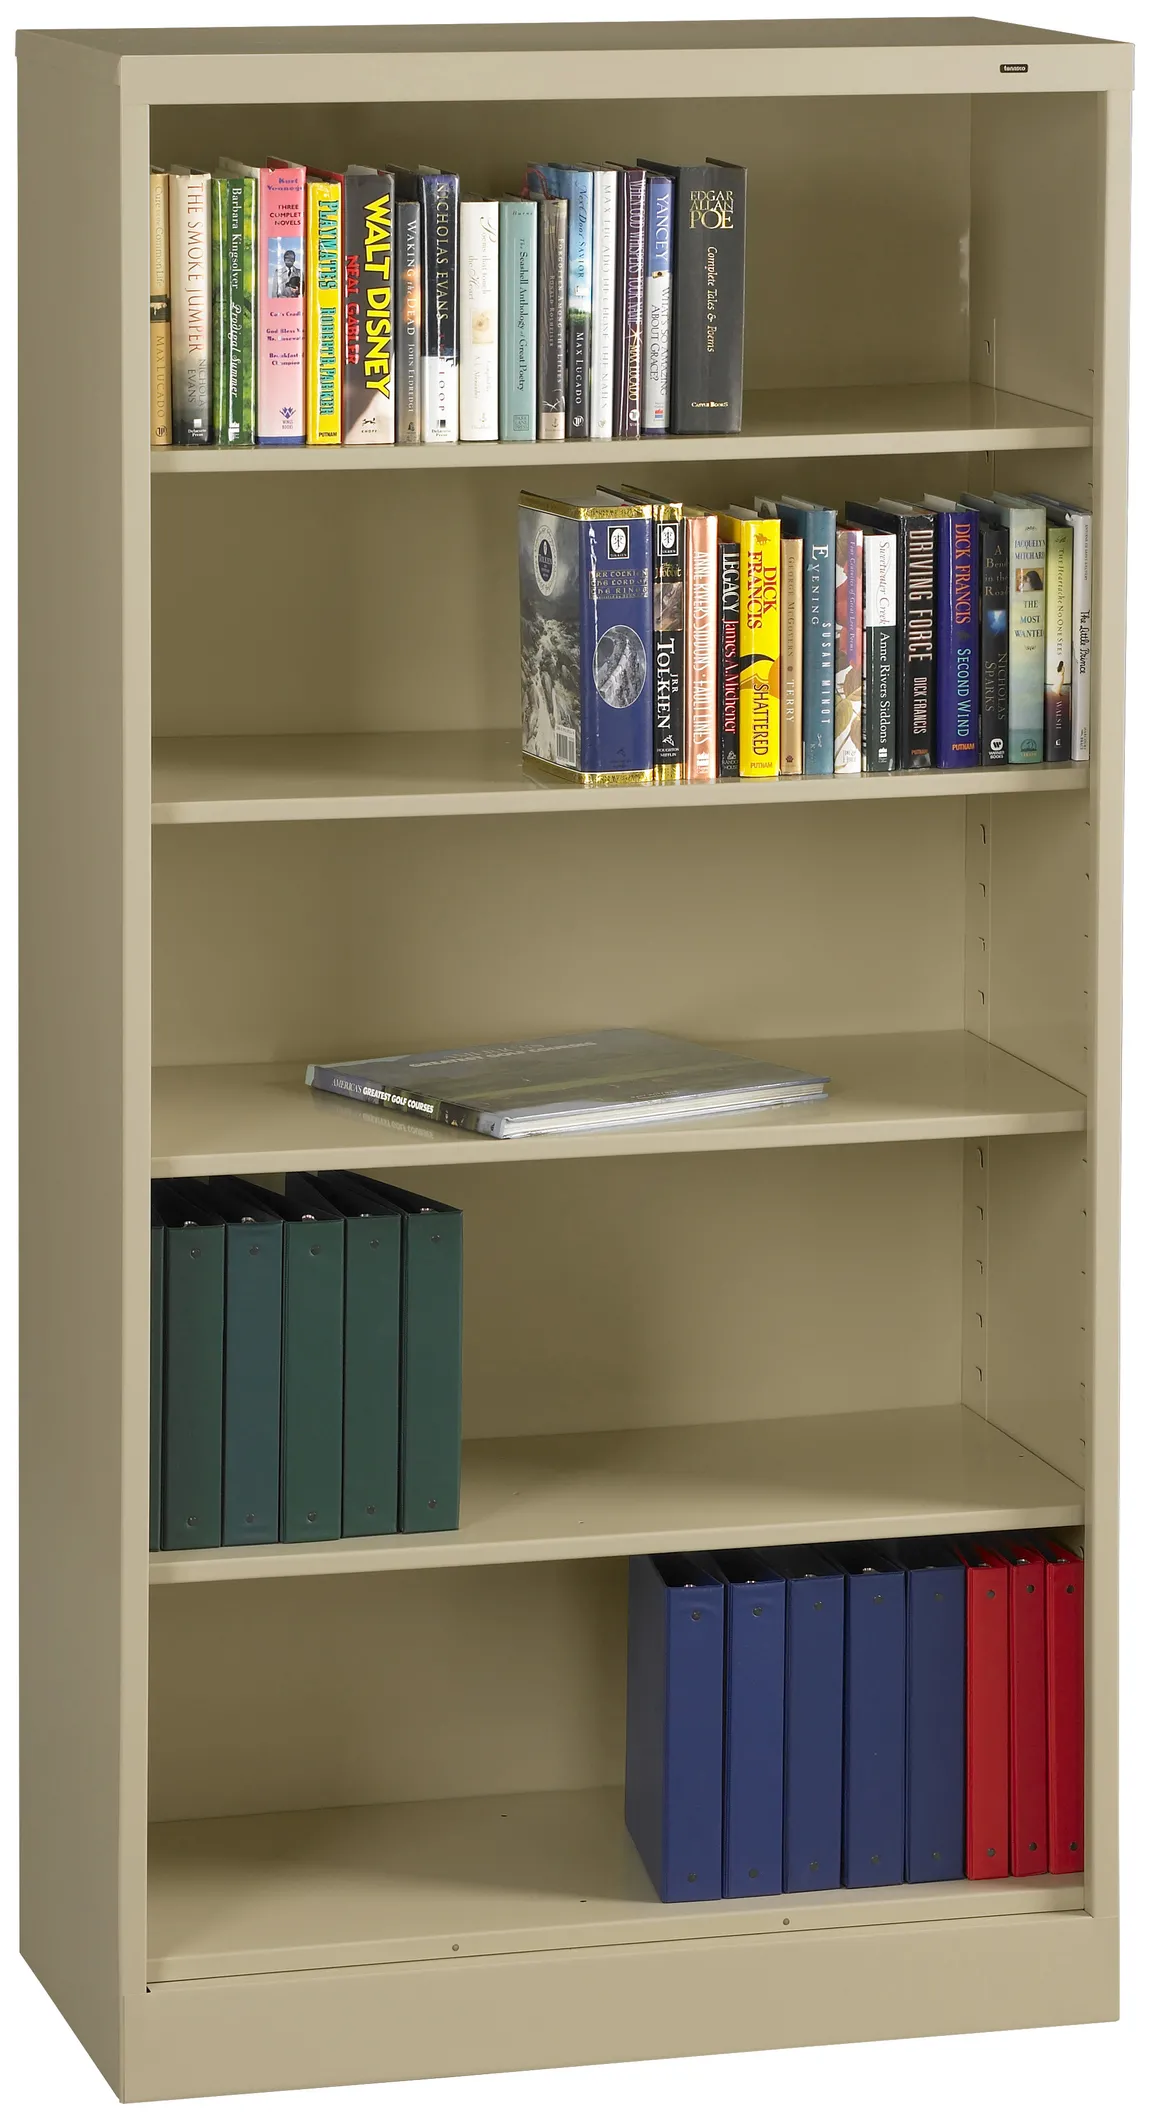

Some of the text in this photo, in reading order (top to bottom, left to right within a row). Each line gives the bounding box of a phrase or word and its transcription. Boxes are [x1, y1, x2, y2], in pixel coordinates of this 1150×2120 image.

[155, 186, 164, 208] Cure
[604, 184, 612, 212] MAX
[629, 180, 645, 208] WHEN
[629, 208, 645, 229] GOD
[689, 210, 734, 230] POE
[690, 190, 734, 201] EDGAR
[690, 200, 734, 214] ALLAN
[229, 188, 242, 289] Barbara Kingsolver
[318, 200, 339, 290] PLAYMATES
[436, 182, 449, 320] NICHOLAS EVANS
[575, 181, 588, 278] Next Door SAVIOR
[628, 231, 645, 273] WHISPERS
[656, 194, 669, 262] YANCEY
[185, 183, 204, 354] THE SMOKE JUMPER
[364, 194, 392, 400] WALT DISNEY
[406, 220, 417, 336] WAKING the DEAD
[345, 254, 360, 364] NEAL GABLER
[516, 250, 529, 392] Seashell Anthology Great Poetry
[660, 286, 670, 326] WHAT'S
[705, 246, 718, 353] Complete Tales & Poems
[228, 302, 242, 398] Prodigal Summer
[320, 306, 336, 356] ROBERT
[650, 304, 660, 382] ABOUT GRACE?
[660, 328, 669, 344] SO
[156, 336, 166, 418] MAX LUCADO
[188, 370, 196, 403] EVANS
[320, 368, 336, 416] PARKER
[575, 360, 584, 404] LUCADO
[629, 366, 639, 400] LUCADO
[660, 346, 668, 396] AMAZING
[955, 523, 971, 624] DICK FRANCIS
[994, 545, 1002, 556] A
[722, 552, 740, 613] LEGACY
[746, 551, 762, 630] FRANCIS
[762, 566, 778, 614] DICK
[812, 544, 829, 625] EVENING
[878, 540, 890, 625] Sweetwater Creek
[908, 530, 934, 662] DRIVING FORCE
[693, 551, 712, 744] ANNE RIVERS SIDDONS FAULT LINES
[722, 619, 740, 660] James
[1020, 616, 1040, 624] MOST
[1080, 610, 1090, 674] The Little Prince
[656, 638, 674, 729] TOLKIEN
[670, 674, 679, 692] JRR
[786, 680, 794, 723] TERRY
[821, 622, 832, 724] SUSAN MINOT
[880, 632, 890, 744] Anne Rivers Siddons
[957, 648, 972, 737] SECOND WIND
[984, 661, 996, 712] SPARKS
[997, 652, 1007, 720] NICHOLAS
[725, 675, 740, 734] Michener
[752, 684, 769, 756] SHATTERED
[913, 676, 928, 734] DICK FRANCIS
[952, 742, 975, 751] PUTNAM
[332, 1078, 434, 1114] AMERICA'S GREATEST GOLF COURSES
